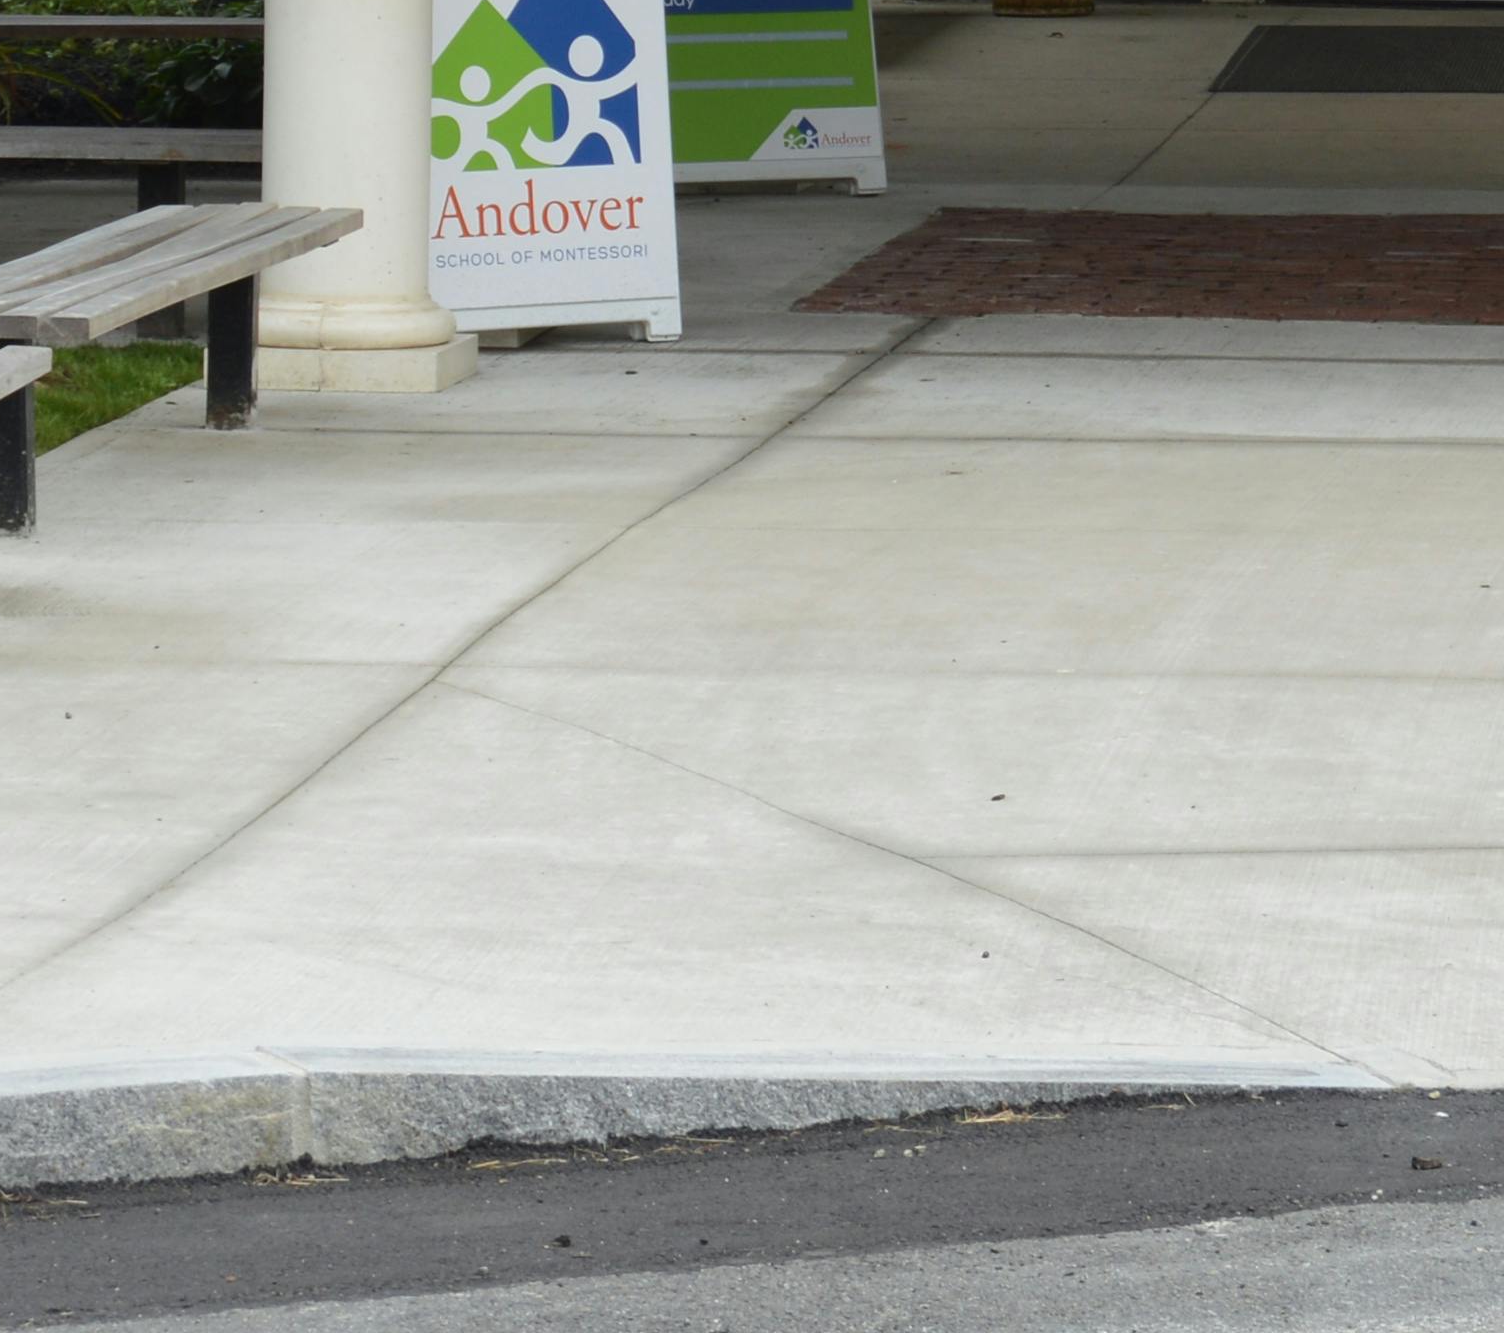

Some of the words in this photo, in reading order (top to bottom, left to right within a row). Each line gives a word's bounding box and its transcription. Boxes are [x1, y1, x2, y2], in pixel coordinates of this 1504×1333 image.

[822, 131, 873, 146] Andover
[431, 178, 644, 240] Andover
[435, 251, 505, 269] SCHOOL
[511, 250, 533, 264] OF
[540, 244, 648, 263] MONTESSORI
